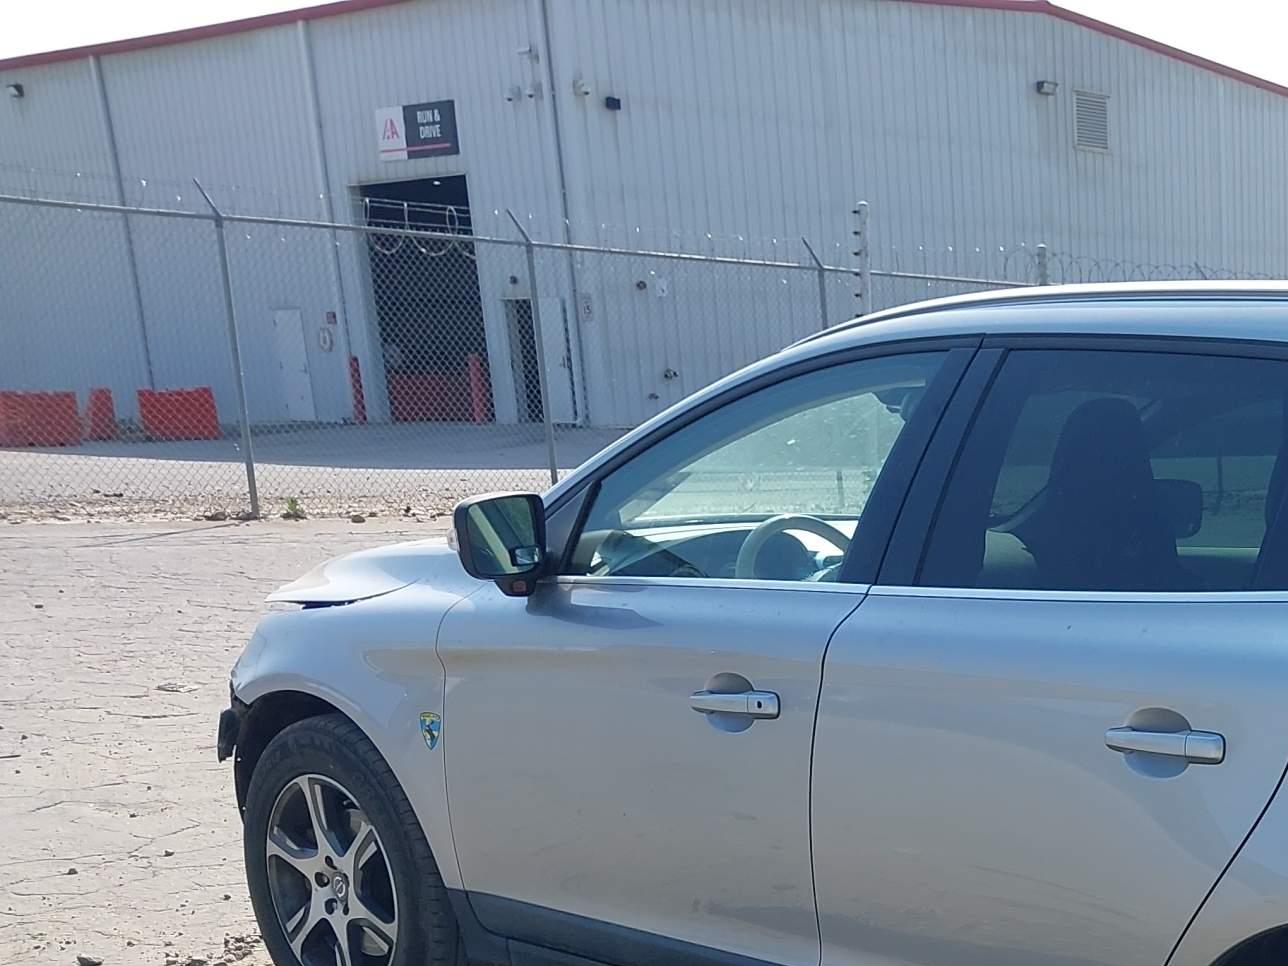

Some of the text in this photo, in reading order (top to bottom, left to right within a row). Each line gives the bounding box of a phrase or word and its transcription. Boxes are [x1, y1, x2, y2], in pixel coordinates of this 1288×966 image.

[417, 109, 441, 123] RUN &
[419, 125, 442, 139] DRIVE
